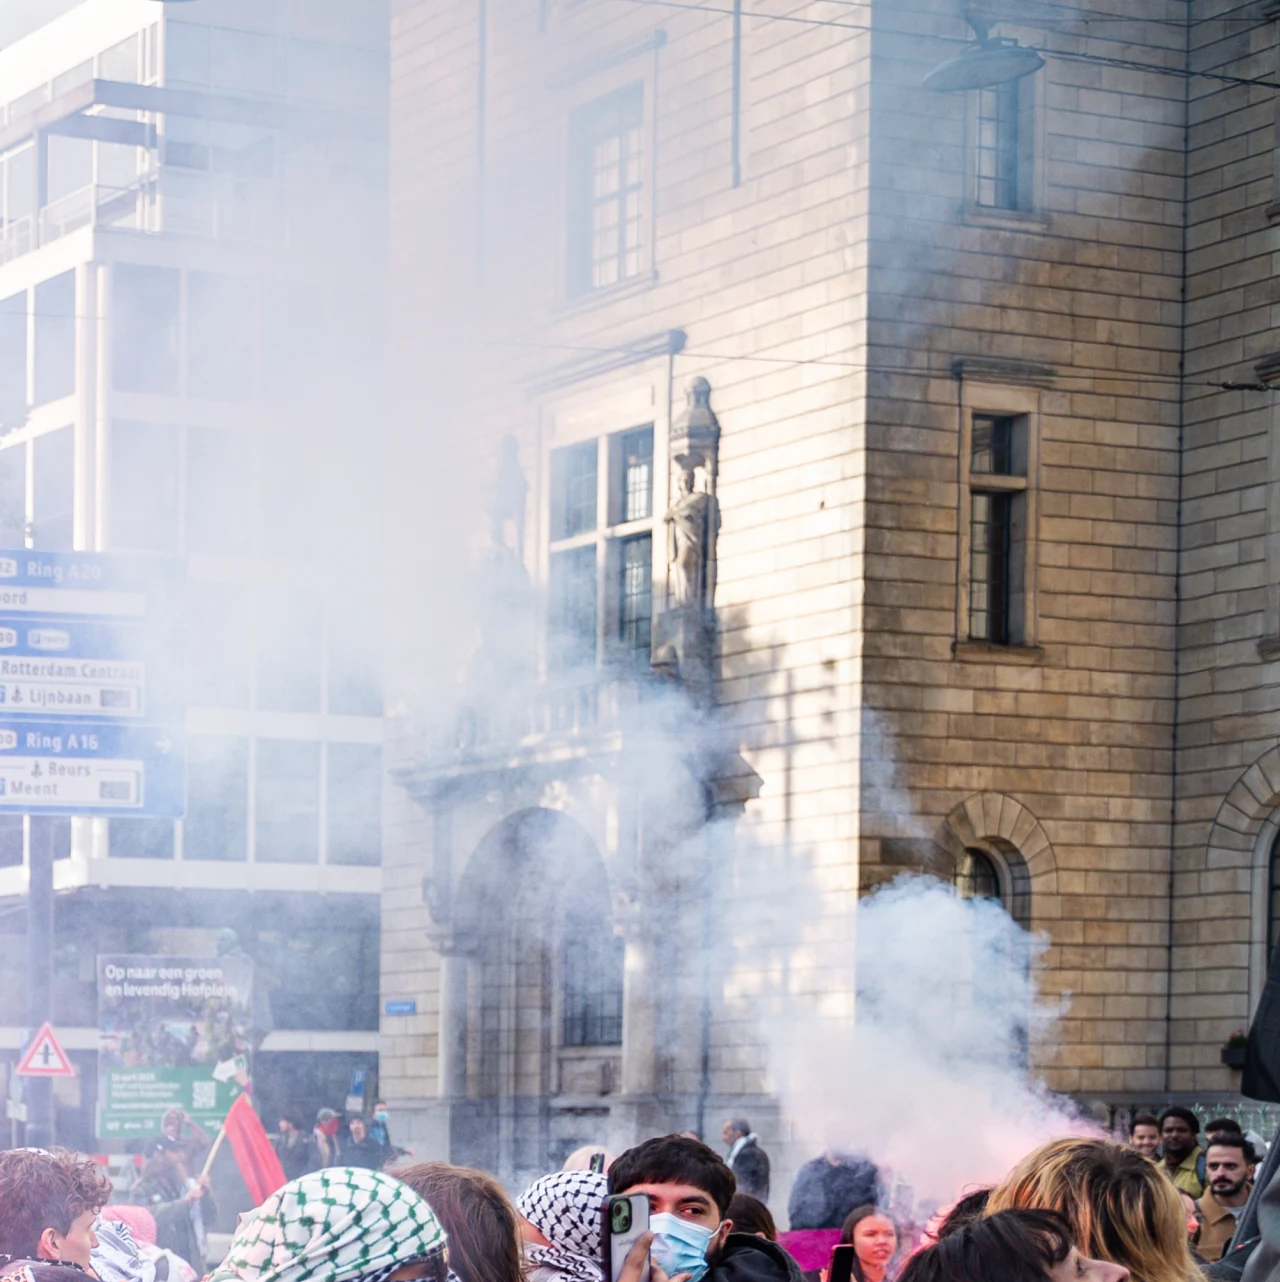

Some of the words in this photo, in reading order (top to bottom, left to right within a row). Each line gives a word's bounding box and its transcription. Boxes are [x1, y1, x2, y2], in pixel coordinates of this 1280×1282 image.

[26, 560, 64, 583] Ring
[0, 660, 77, 677] Rotterdam
[29, 688, 92, 708] Lijnbaan
[26, 731, 62, 753] Ring
[48, 761, 92, 777] Beurs
[10, 780, 59, 796] Meent
[105, 964, 126, 982] Op
[126, 967, 157, 980] naar
[158, 967, 183, 980] een
[184, 967, 223, 982] groen
[105, 983, 123, 997] en
[123, 981, 181, 1000] levendig
[181, 982, 238, 999] Hofplein
